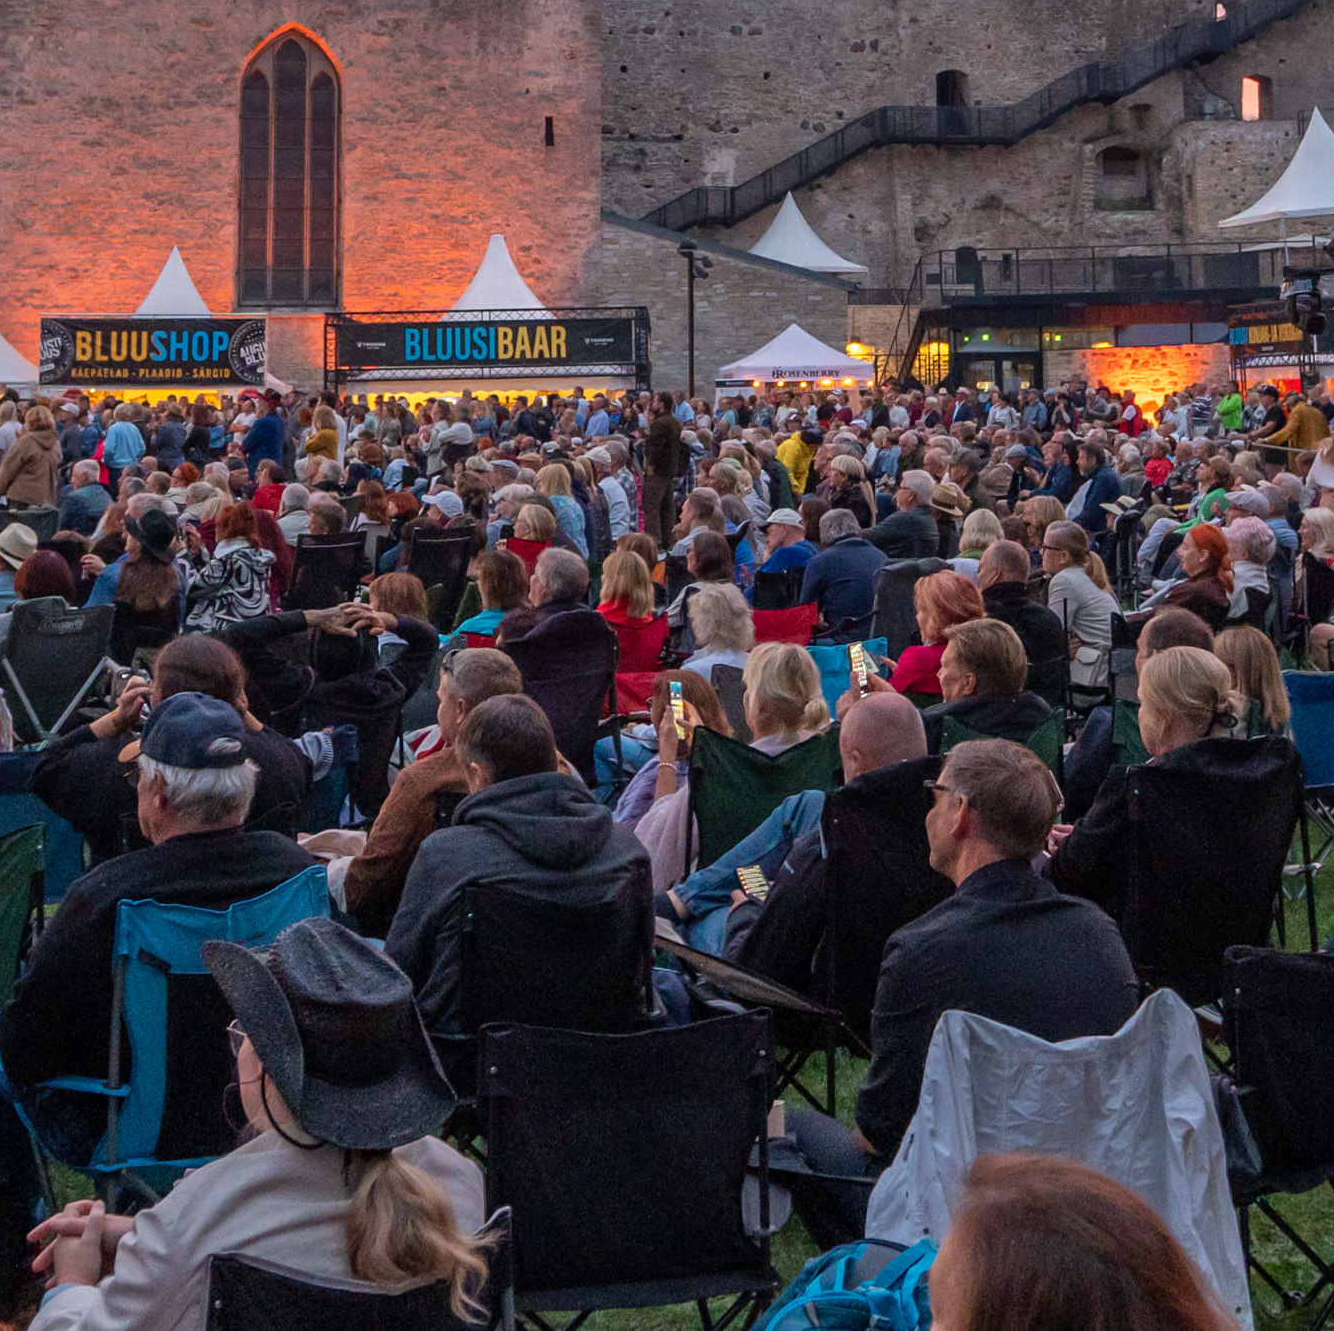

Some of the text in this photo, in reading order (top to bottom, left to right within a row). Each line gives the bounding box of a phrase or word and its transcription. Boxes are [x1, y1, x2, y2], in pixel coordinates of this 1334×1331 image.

[75, 330, 230, 362] BLUUSHOP
[404, 325, 567, 361] BLUUSIBAAR
[70, 366, 231, 379] KÄEPAELAD PLAADID SÄRGID
